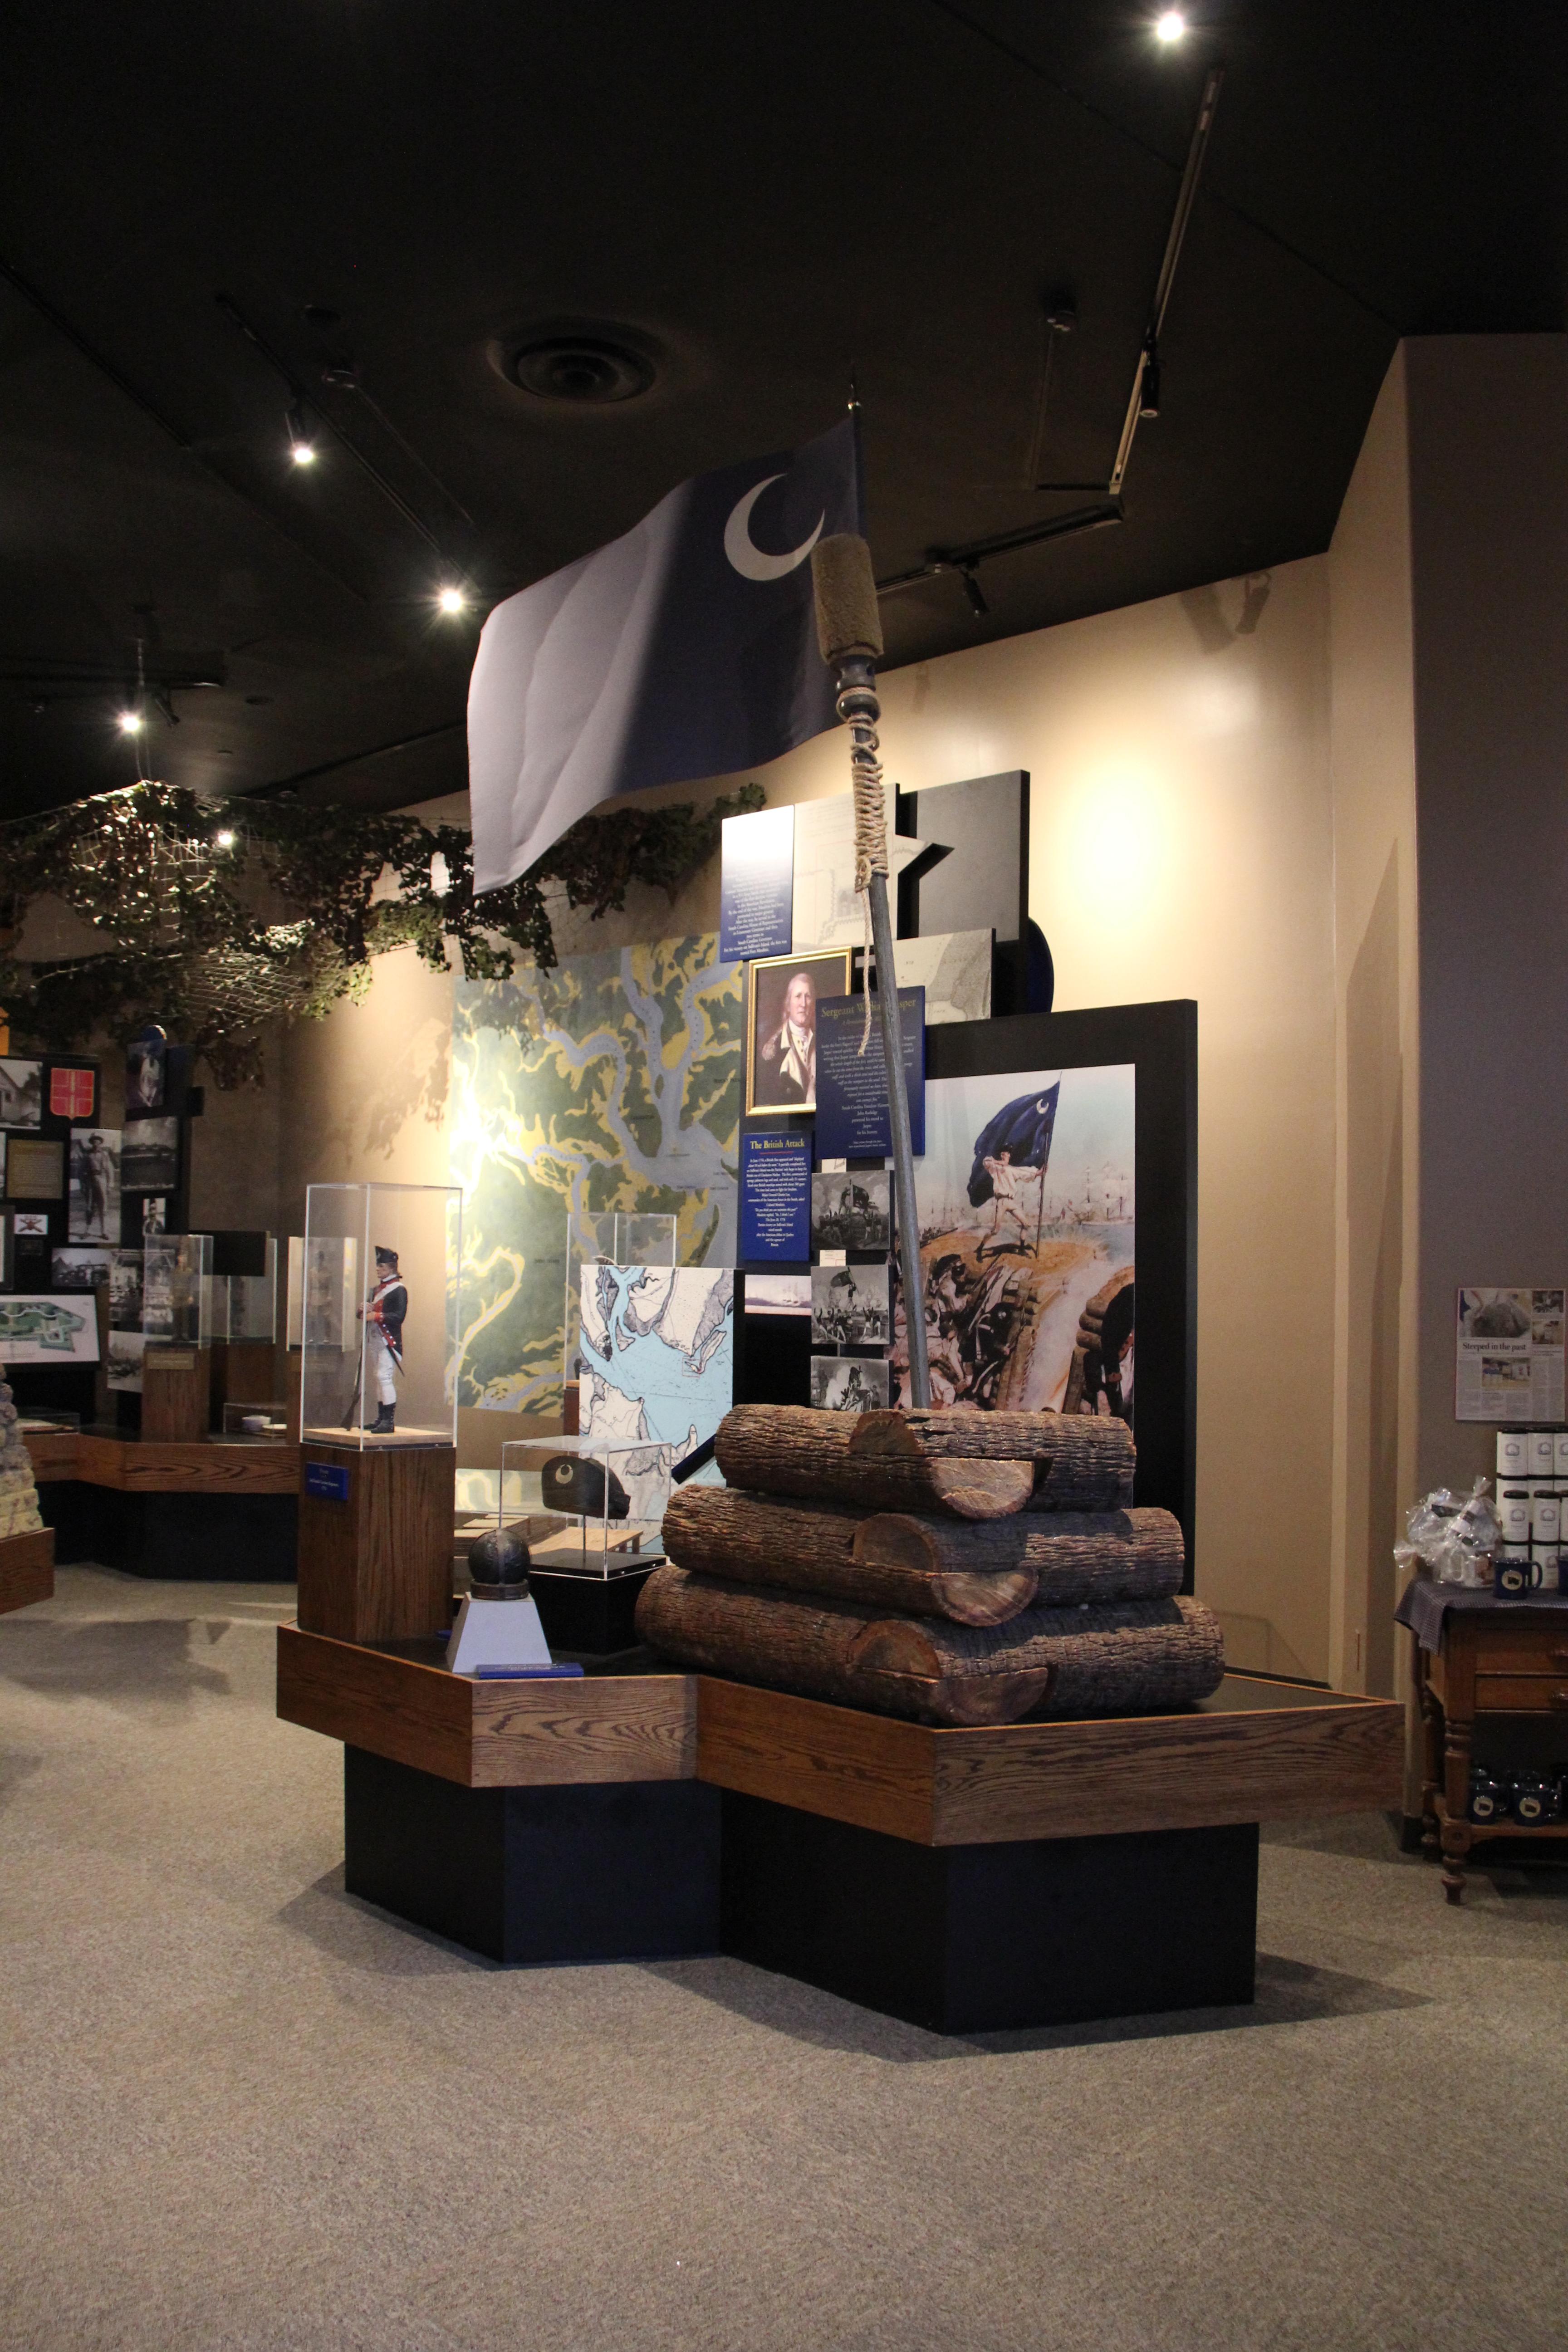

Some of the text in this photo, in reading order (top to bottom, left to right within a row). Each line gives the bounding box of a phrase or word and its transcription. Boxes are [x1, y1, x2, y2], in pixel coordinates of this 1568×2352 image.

[750, 1138, 805, 1149] The British Attack
[1463, 1342, 1490, 1352] Steeped
